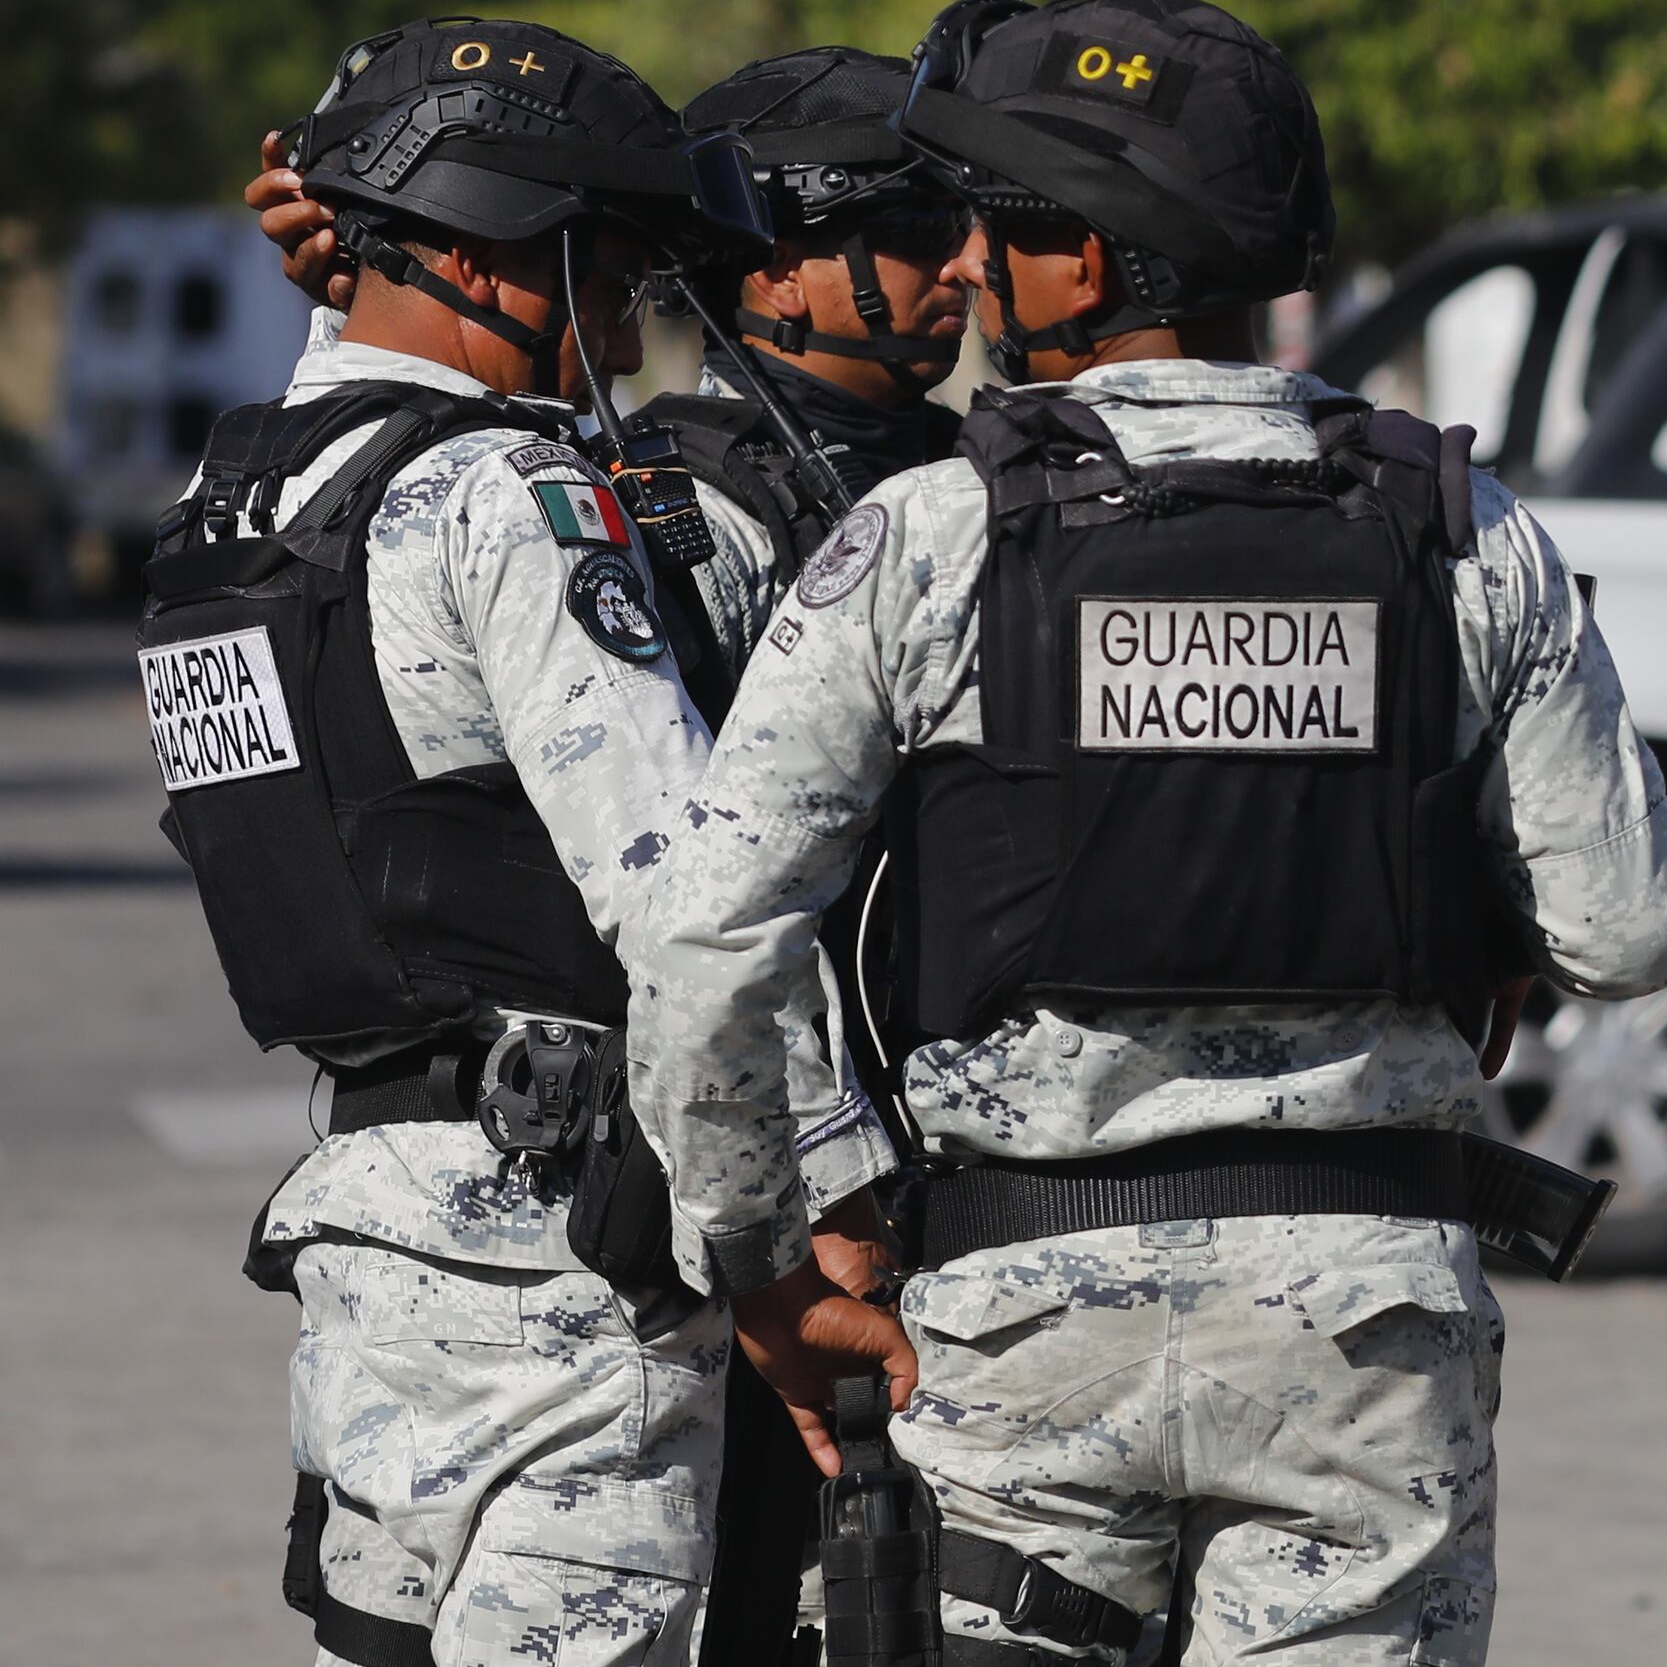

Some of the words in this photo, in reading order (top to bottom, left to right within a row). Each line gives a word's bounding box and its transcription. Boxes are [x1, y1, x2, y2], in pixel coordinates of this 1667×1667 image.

[1077, 45, 1153, 89] O+
[1100, 609, 1349, 666] GUARDIA
[147, 642, 260, 719] GUARDIA
[1100, 683, 1359, 739] NACIONAL
[153, 705, 287, 782] NACIONAL
